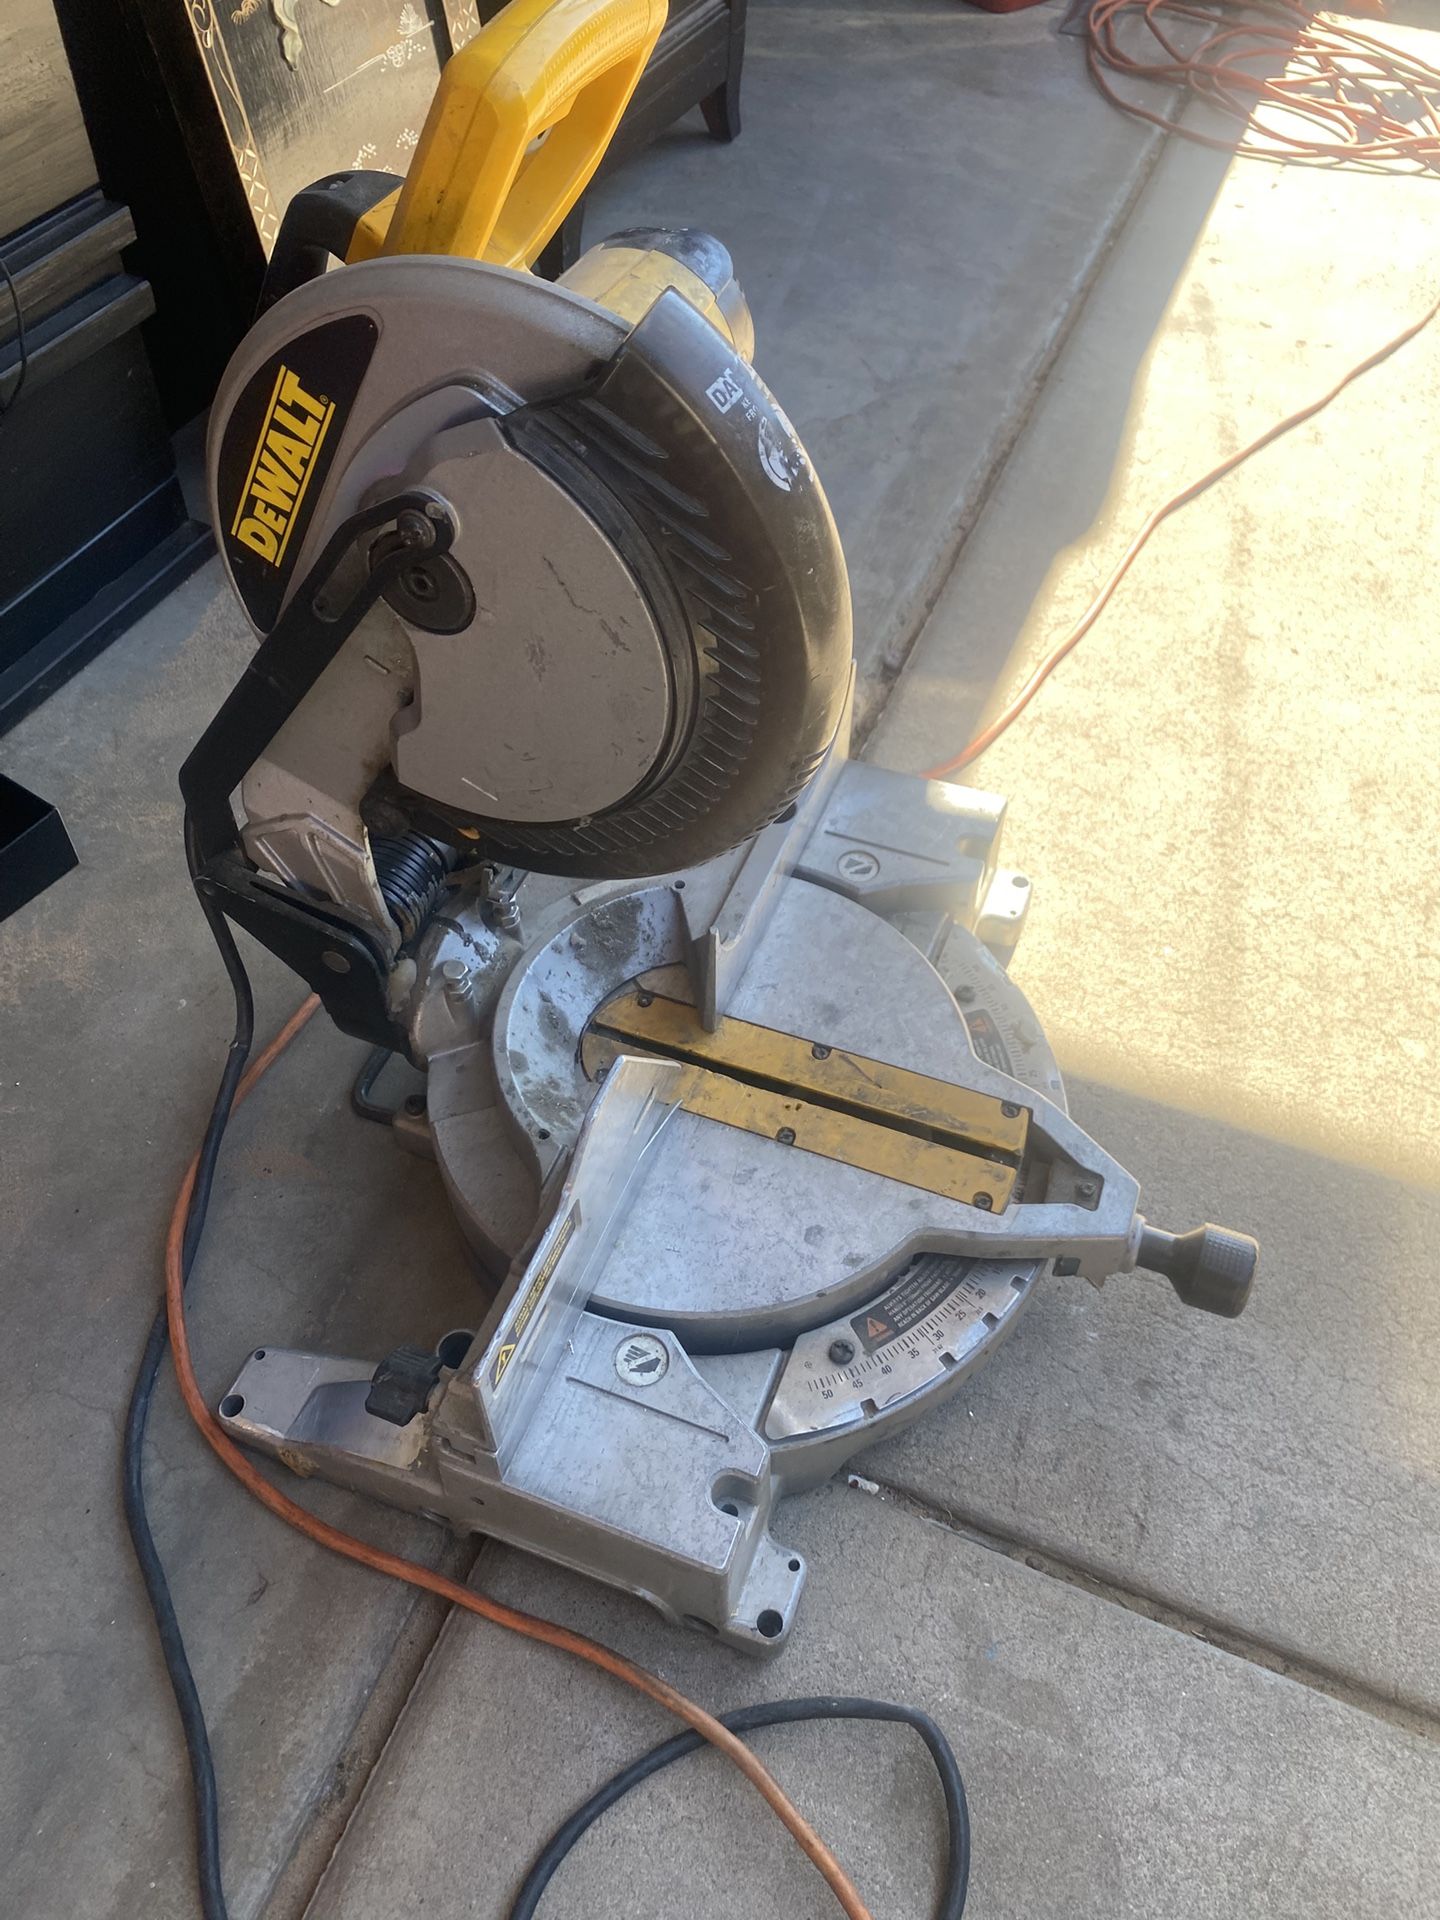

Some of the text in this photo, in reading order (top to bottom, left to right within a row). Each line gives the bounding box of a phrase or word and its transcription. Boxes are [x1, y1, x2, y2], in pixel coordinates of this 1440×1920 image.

[237, 369, 327, 564] DEWALT
[975, 1288, 986, 1299] 20
[955, 1310, 966, 1321] 25
[933, 1329, 944, 1341] 30
[907, 1348, 920, 1359] 35
[881, 1365, 892, 1375] 40
[852, 1379, 864, 1389] 45
[822, 1389, 833, 1399] 50
